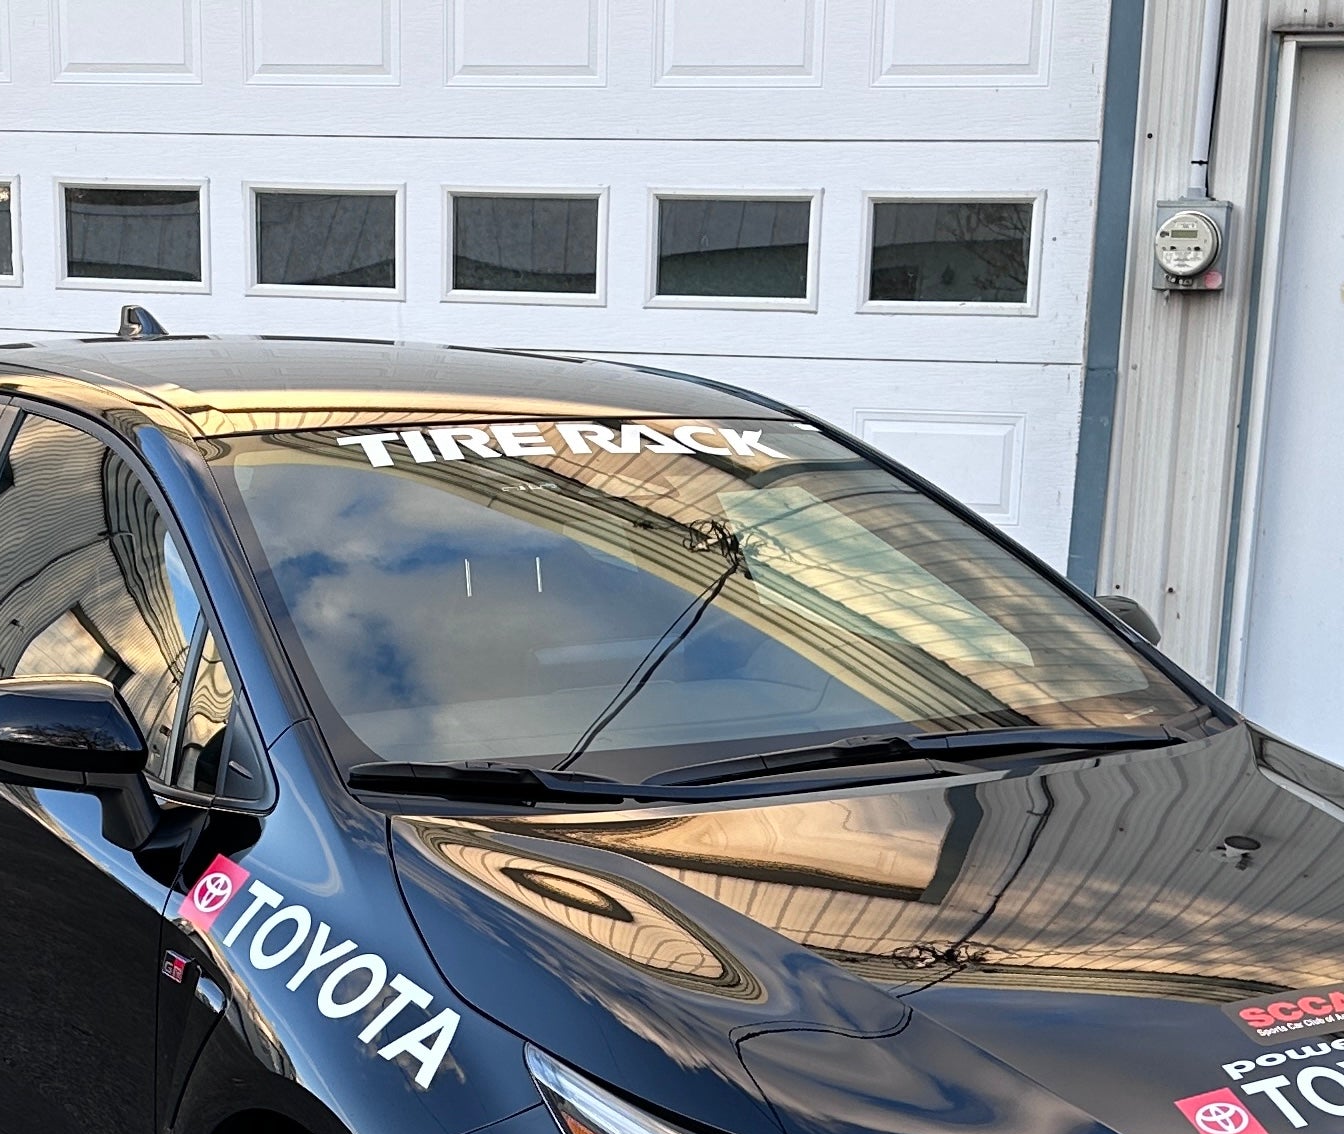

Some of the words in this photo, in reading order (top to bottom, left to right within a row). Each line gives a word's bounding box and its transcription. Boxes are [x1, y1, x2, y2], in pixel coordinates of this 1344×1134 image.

[337, 423, 555, 467] TIRE
[555, 423, 790, 459] RACK
[223, 880, 461, 1089] TOYOTA
[1257, 1025, 1288, 1037] Sports
[1287, 1022, 1304, 1030] Car
[1304, 1018, 1325, 1027] Club
[1325, 1014, 1335, 1023] of
